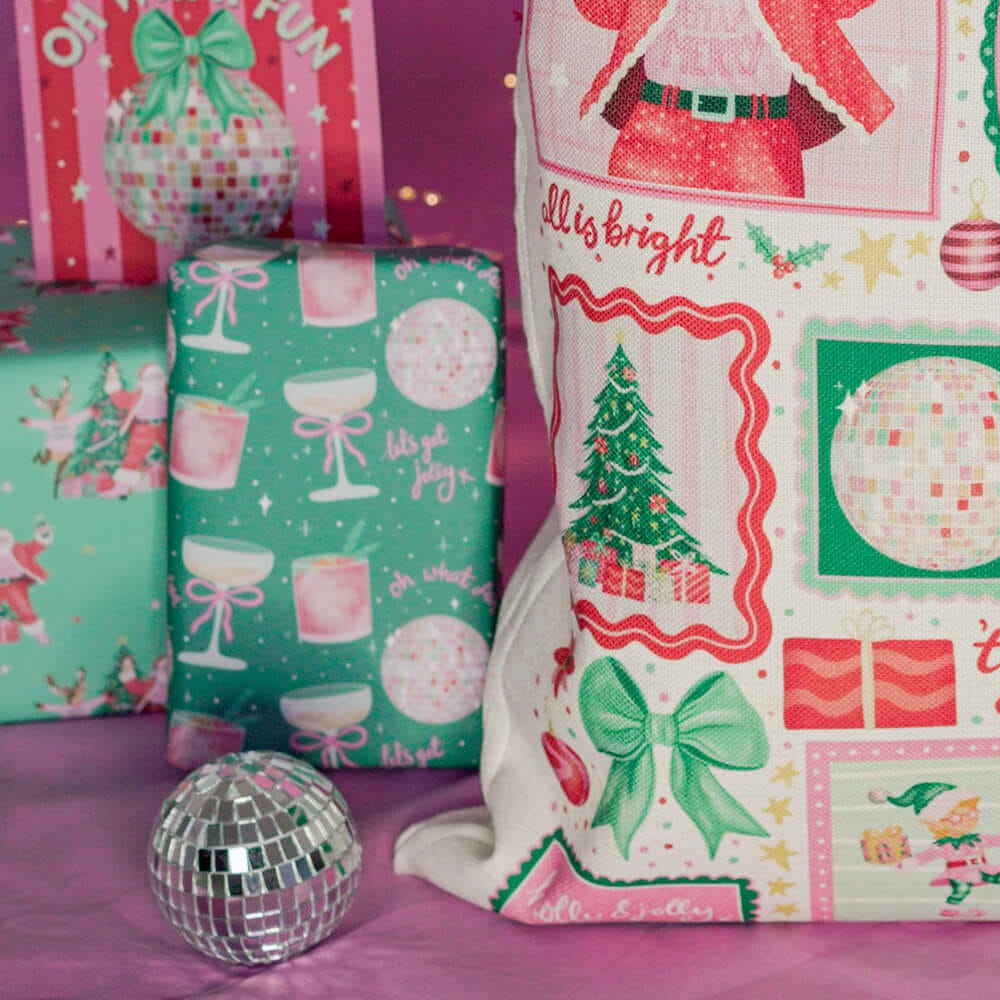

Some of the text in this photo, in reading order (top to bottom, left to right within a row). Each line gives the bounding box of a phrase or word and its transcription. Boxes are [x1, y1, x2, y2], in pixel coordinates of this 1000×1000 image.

[42, 0, 107, 68] OH
[573, 203, 598, 249] is
[601, 198, 732, 276] bright
